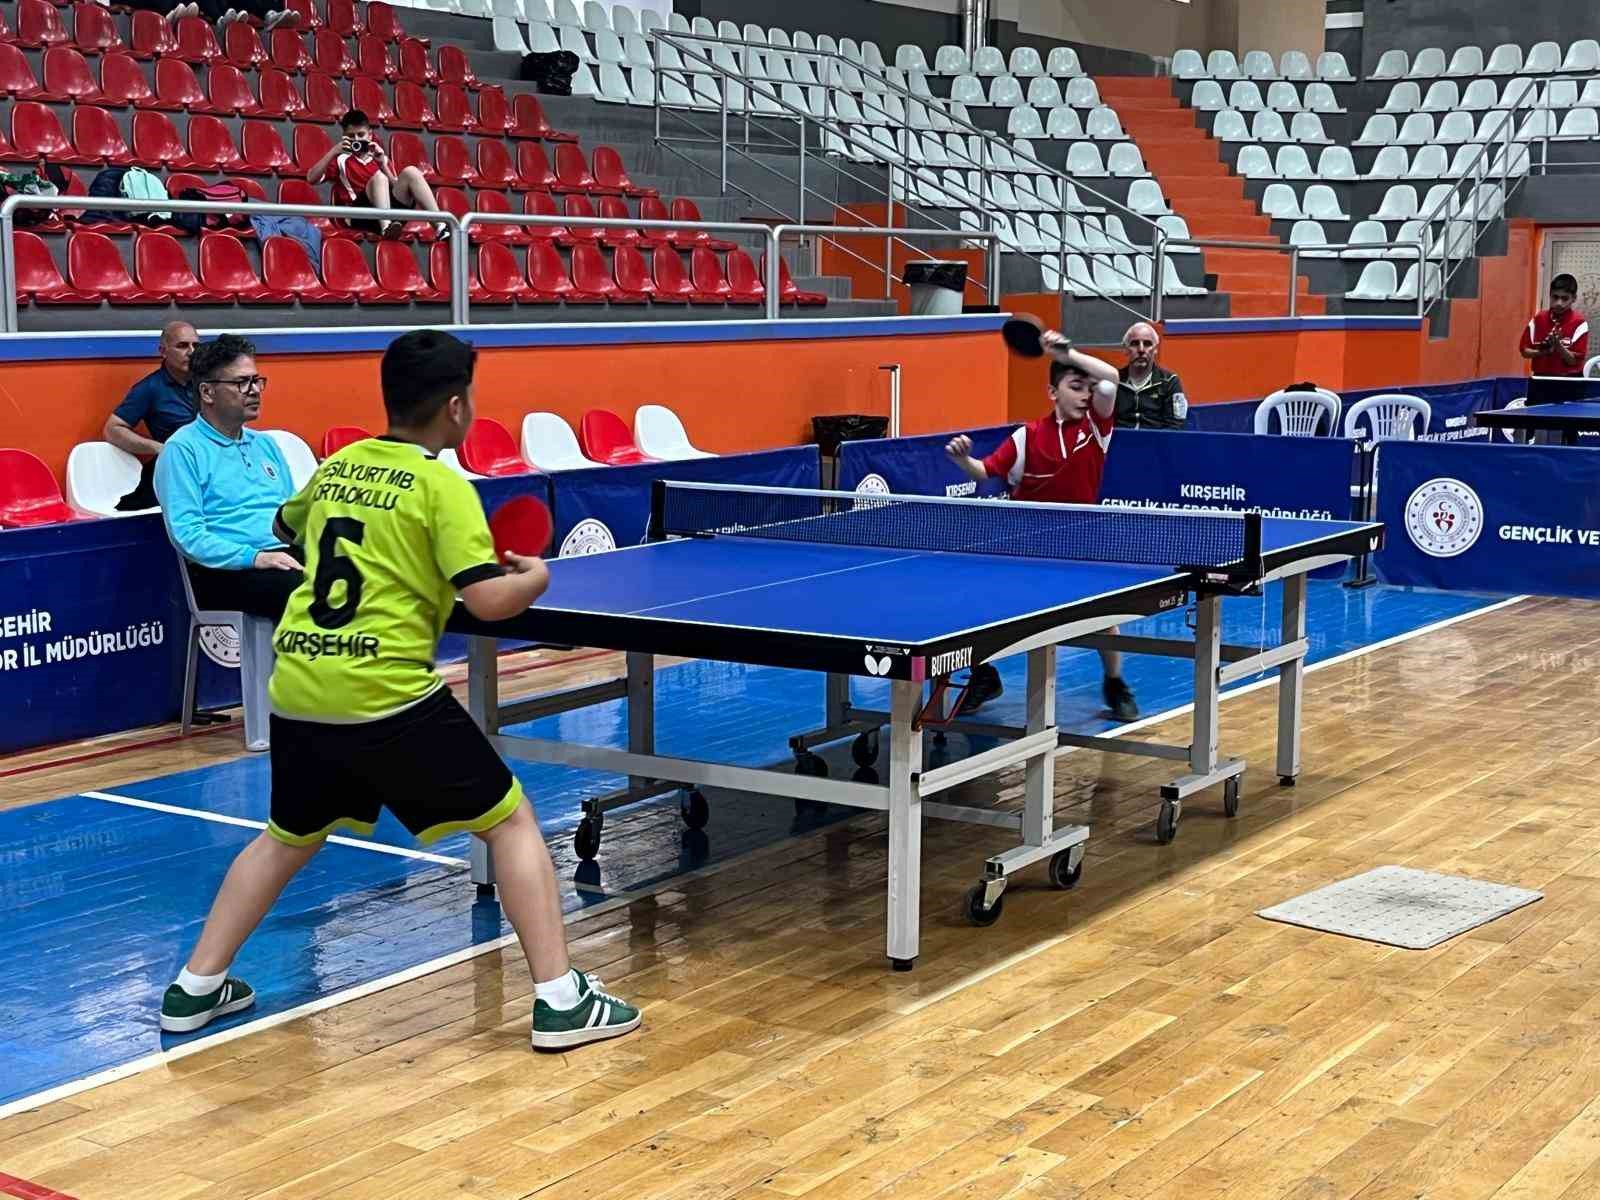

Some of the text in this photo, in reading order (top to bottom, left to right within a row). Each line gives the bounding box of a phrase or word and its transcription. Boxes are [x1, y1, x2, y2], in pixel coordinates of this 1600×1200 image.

[323, 459, 389, 483] ŞİLYURT
[1180, 484, 1246, 501] KIRŞEHİR
[1498, 525, 1600, 546] GENÇLİK VE
[308, 516, 366, 630] 6
[0, 609, 51, 638] EHİR
[0, 620, 164, 671] R İL MÜDÜRLÜĞÜ
[276, 630, 379, 661] KIRŞEHİR
[931, 646, 973, 677] BUTTERFLY
